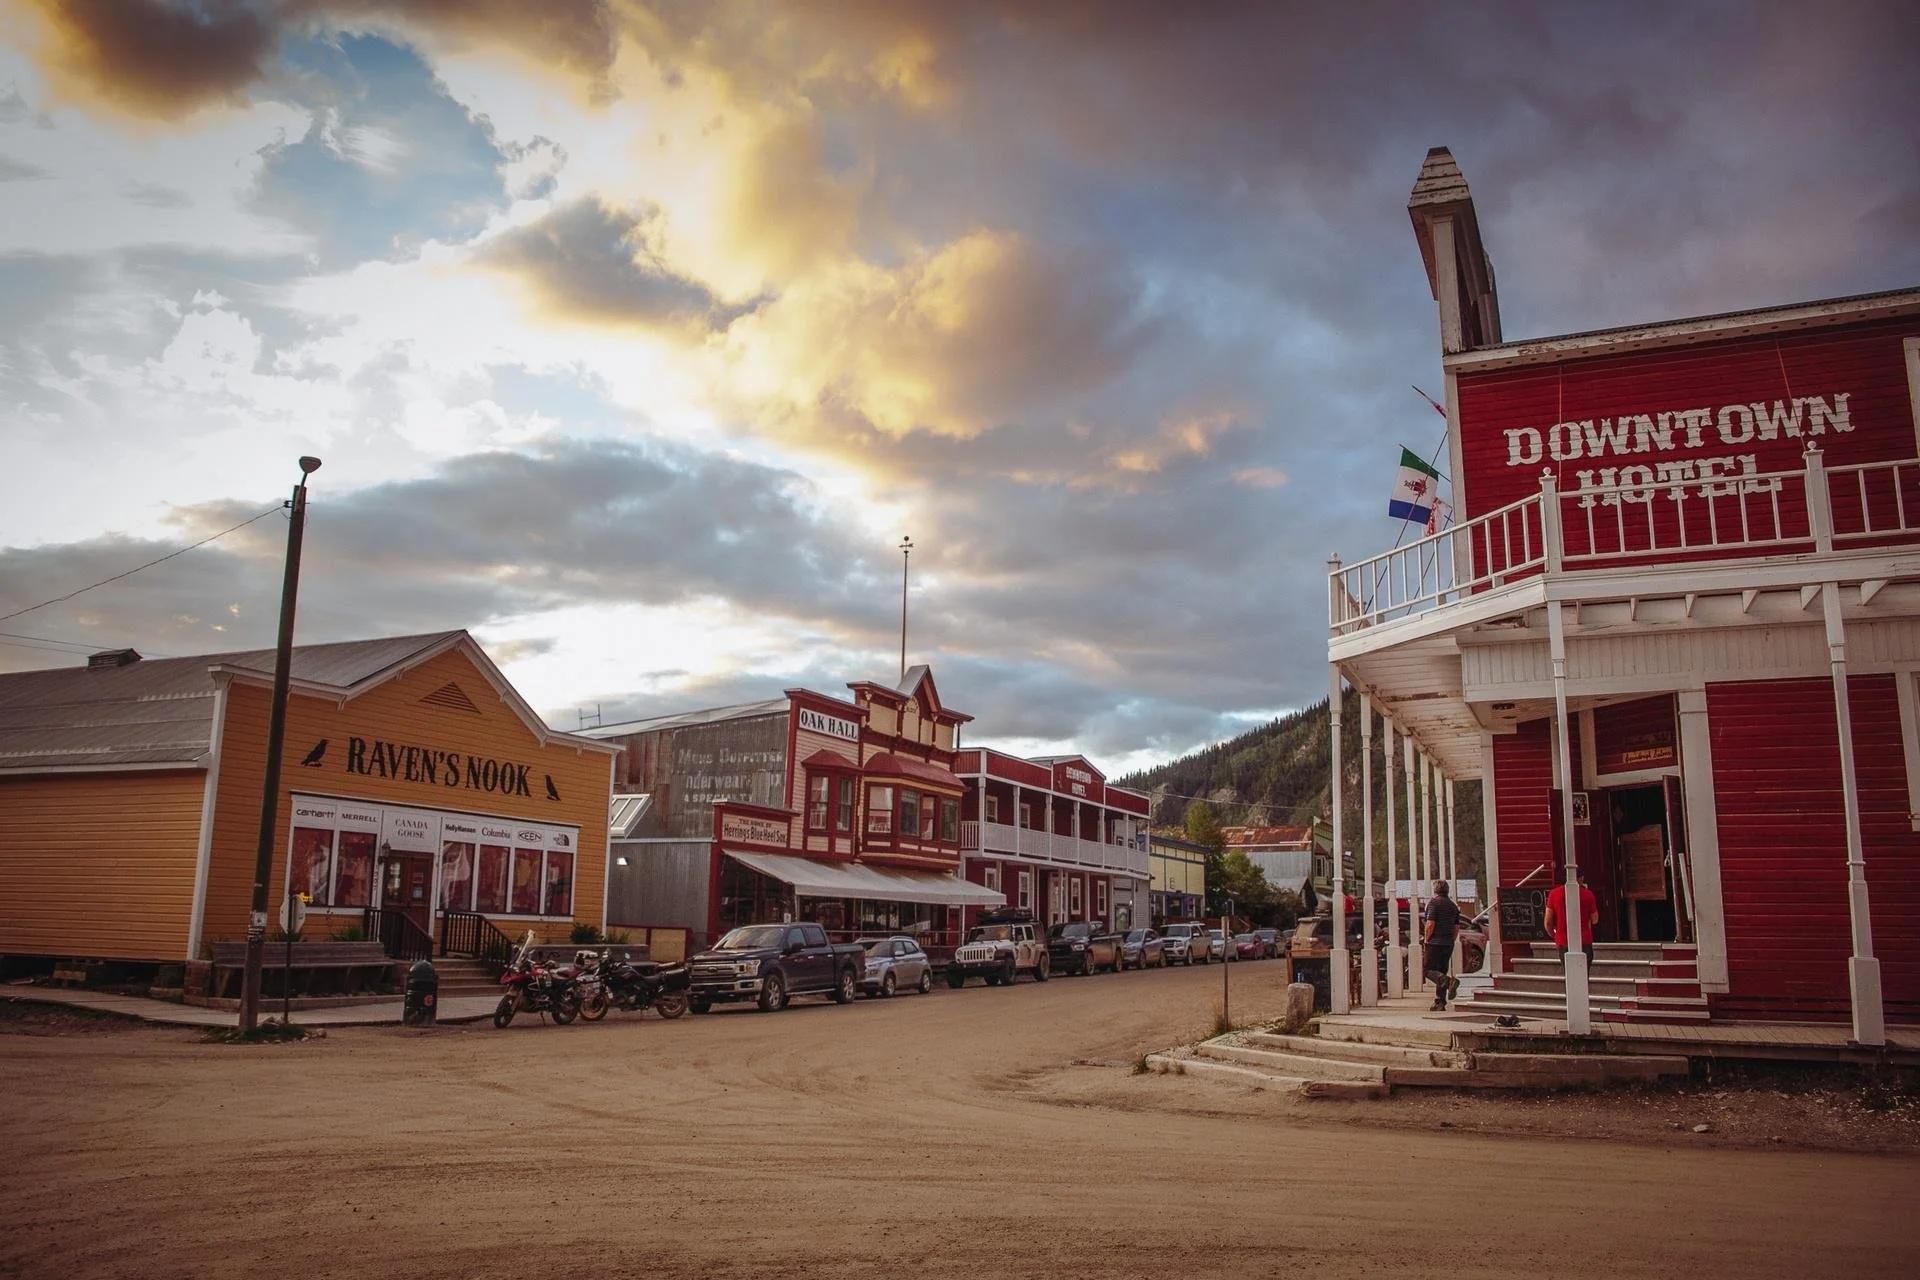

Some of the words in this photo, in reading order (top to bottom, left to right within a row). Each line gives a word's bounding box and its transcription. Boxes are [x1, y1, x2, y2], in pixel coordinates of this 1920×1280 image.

[1503, 392, 1856, 466] DOWNTOWN
[1576, 453, 1783, 508] HOTEL
[800, 710, 825, 731] OAK
[828, 719, 858, 739] HALL
[346, 736, 459, 787] RAVEN'S
[465, 755, 532, 797] NOOK
[296, 808, 334, 819] carhartt
[341, 812, 377, 823] MERRELL
[395, 818, 429, 830] CANADA
[397, 829, 425, 839] GOOSE
[481, 826, 511, 840] Columbia
[518, 831, 542, 841] KEEN
